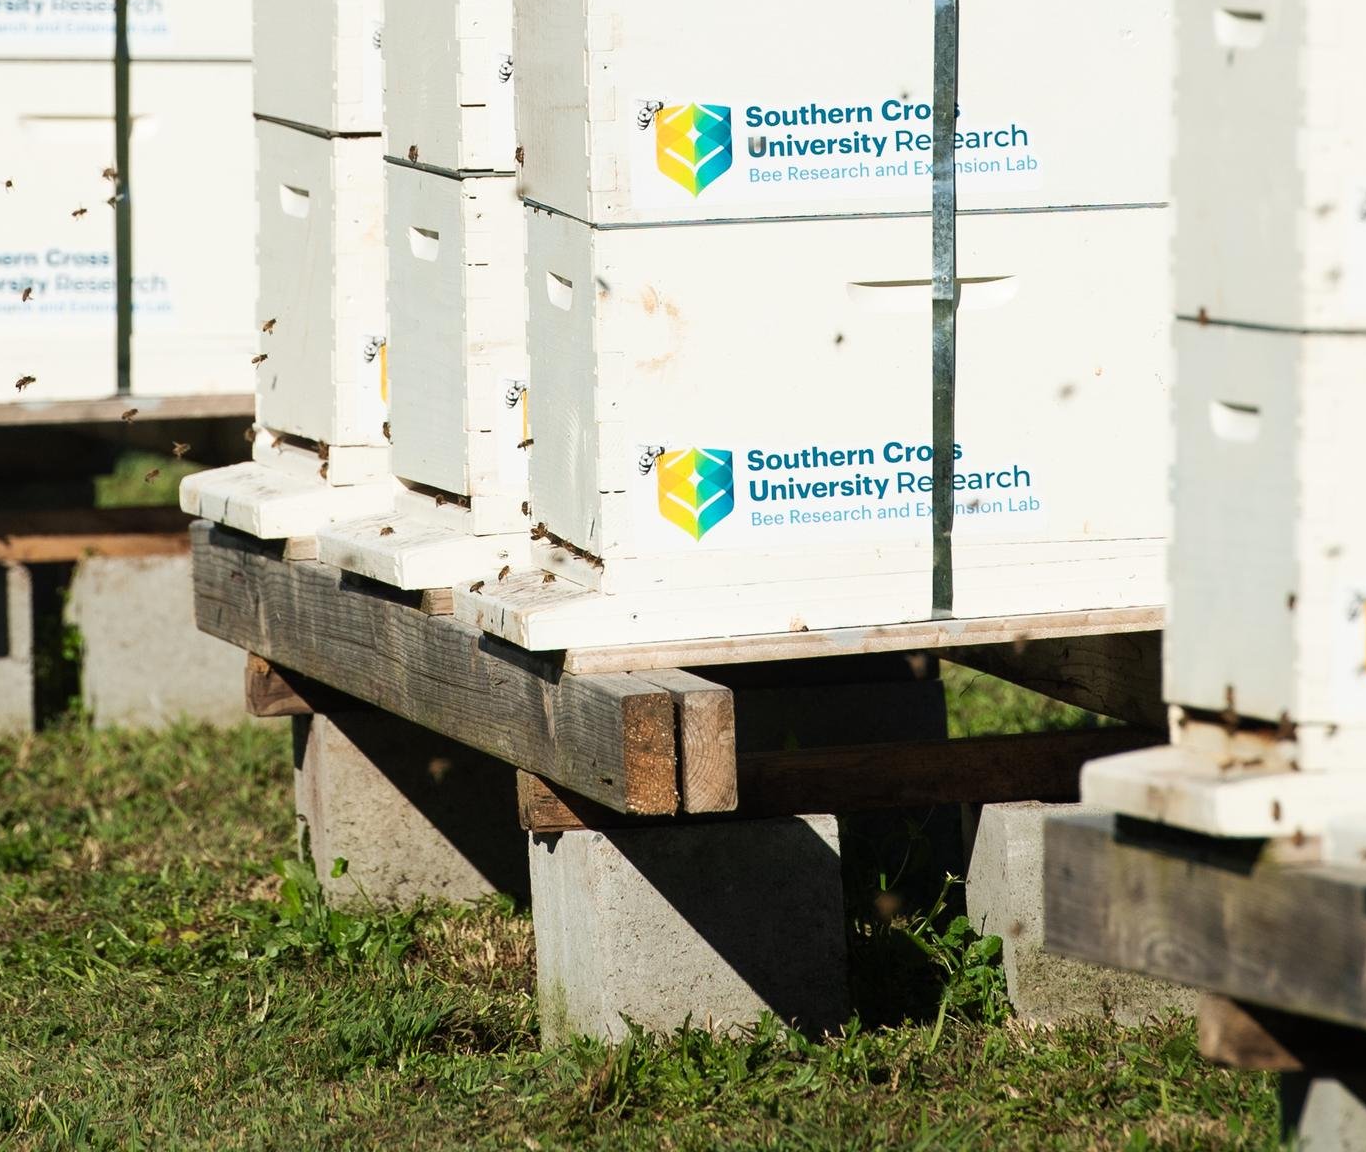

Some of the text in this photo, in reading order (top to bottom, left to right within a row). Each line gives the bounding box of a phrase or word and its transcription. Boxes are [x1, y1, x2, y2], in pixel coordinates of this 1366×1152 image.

[746, 99, 960, 128] Southern Cros
[748, 124, 1028, 157] University Reearch
[749, 155, 1038, 183] Bee Research and Exnsion Lab
[46, 249, 109, 266] Cross
[747, 441, 963, 471] Southern Cros
[749, 465, 1030, 502] University Reearch
[752, 495, 1040, 526] Bee Research and Exnsion Lab
